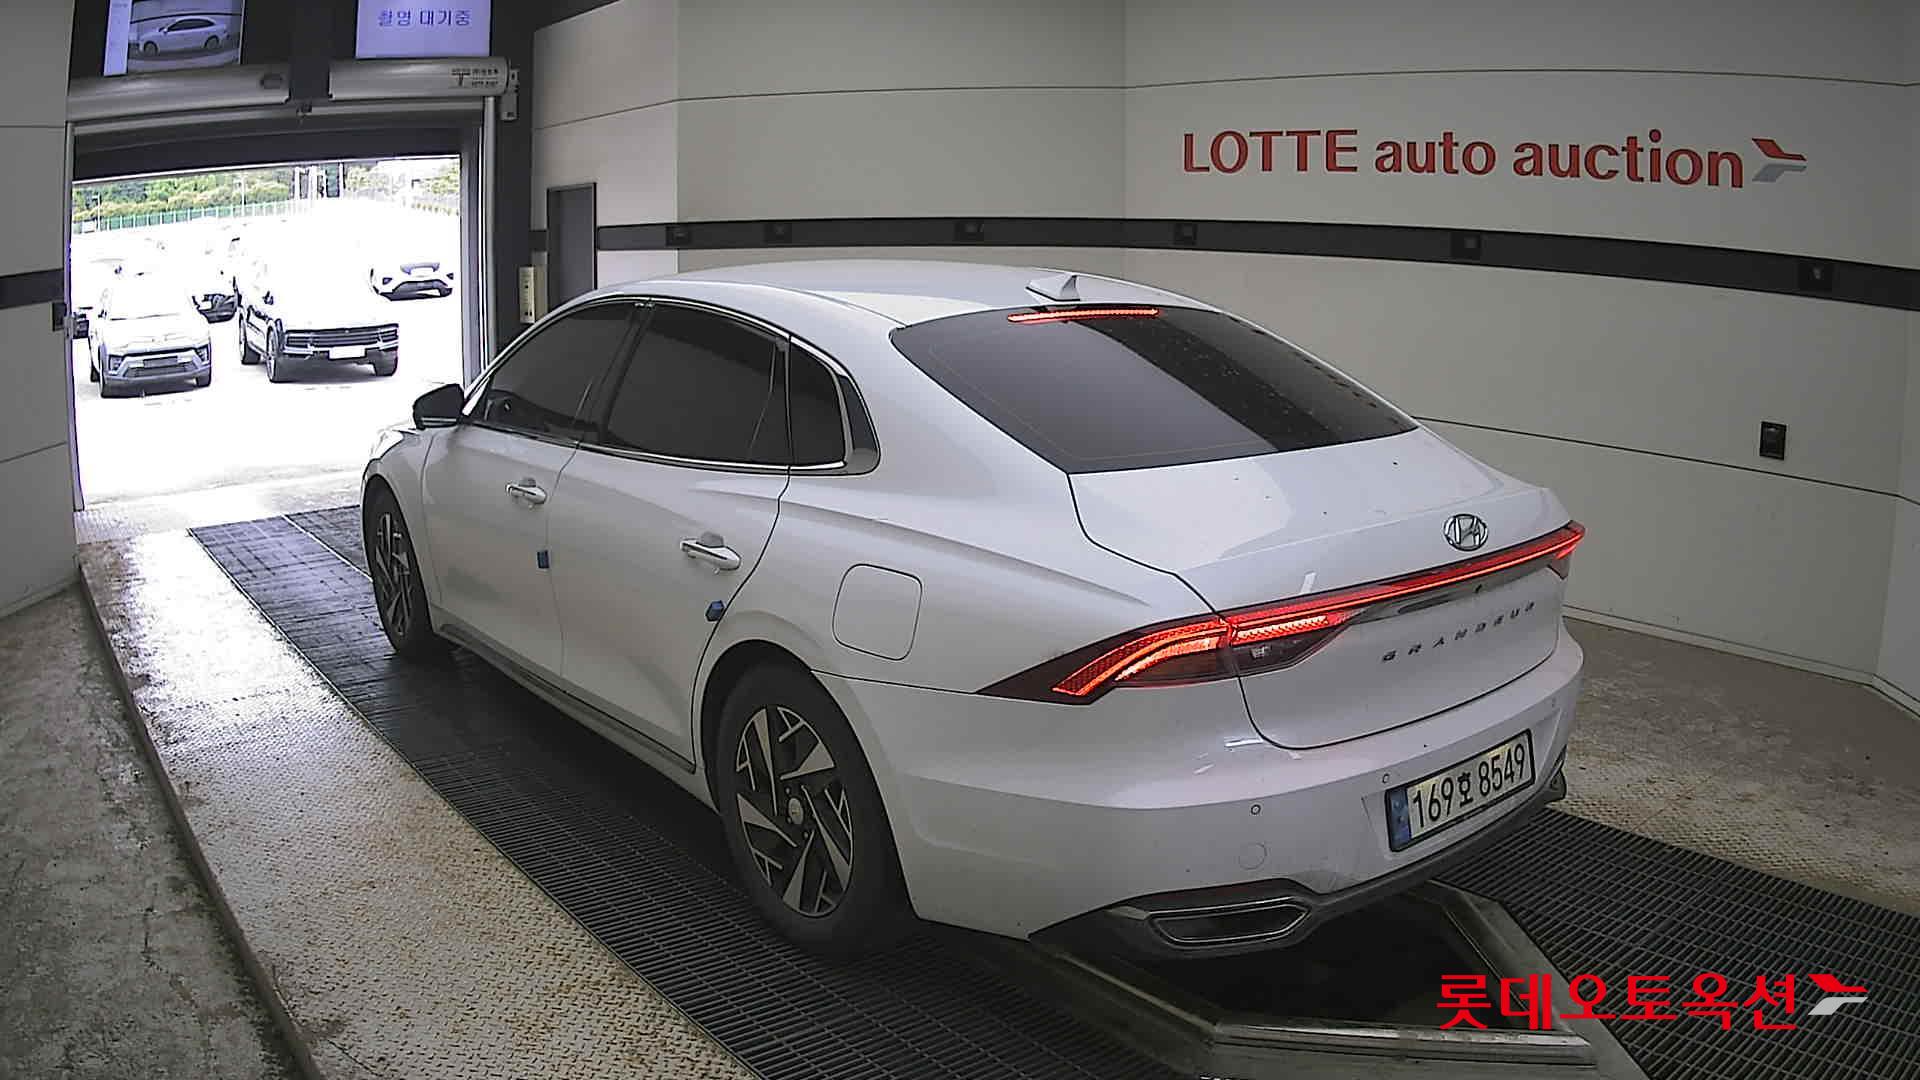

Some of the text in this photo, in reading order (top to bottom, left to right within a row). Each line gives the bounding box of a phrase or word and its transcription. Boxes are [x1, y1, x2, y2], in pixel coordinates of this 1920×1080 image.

[419, 9, 472, 27] 대기중
[1182, 128, 1744, 189] LOTTE auto auction
[1413, 743, 1526, 828] 169호 8549
